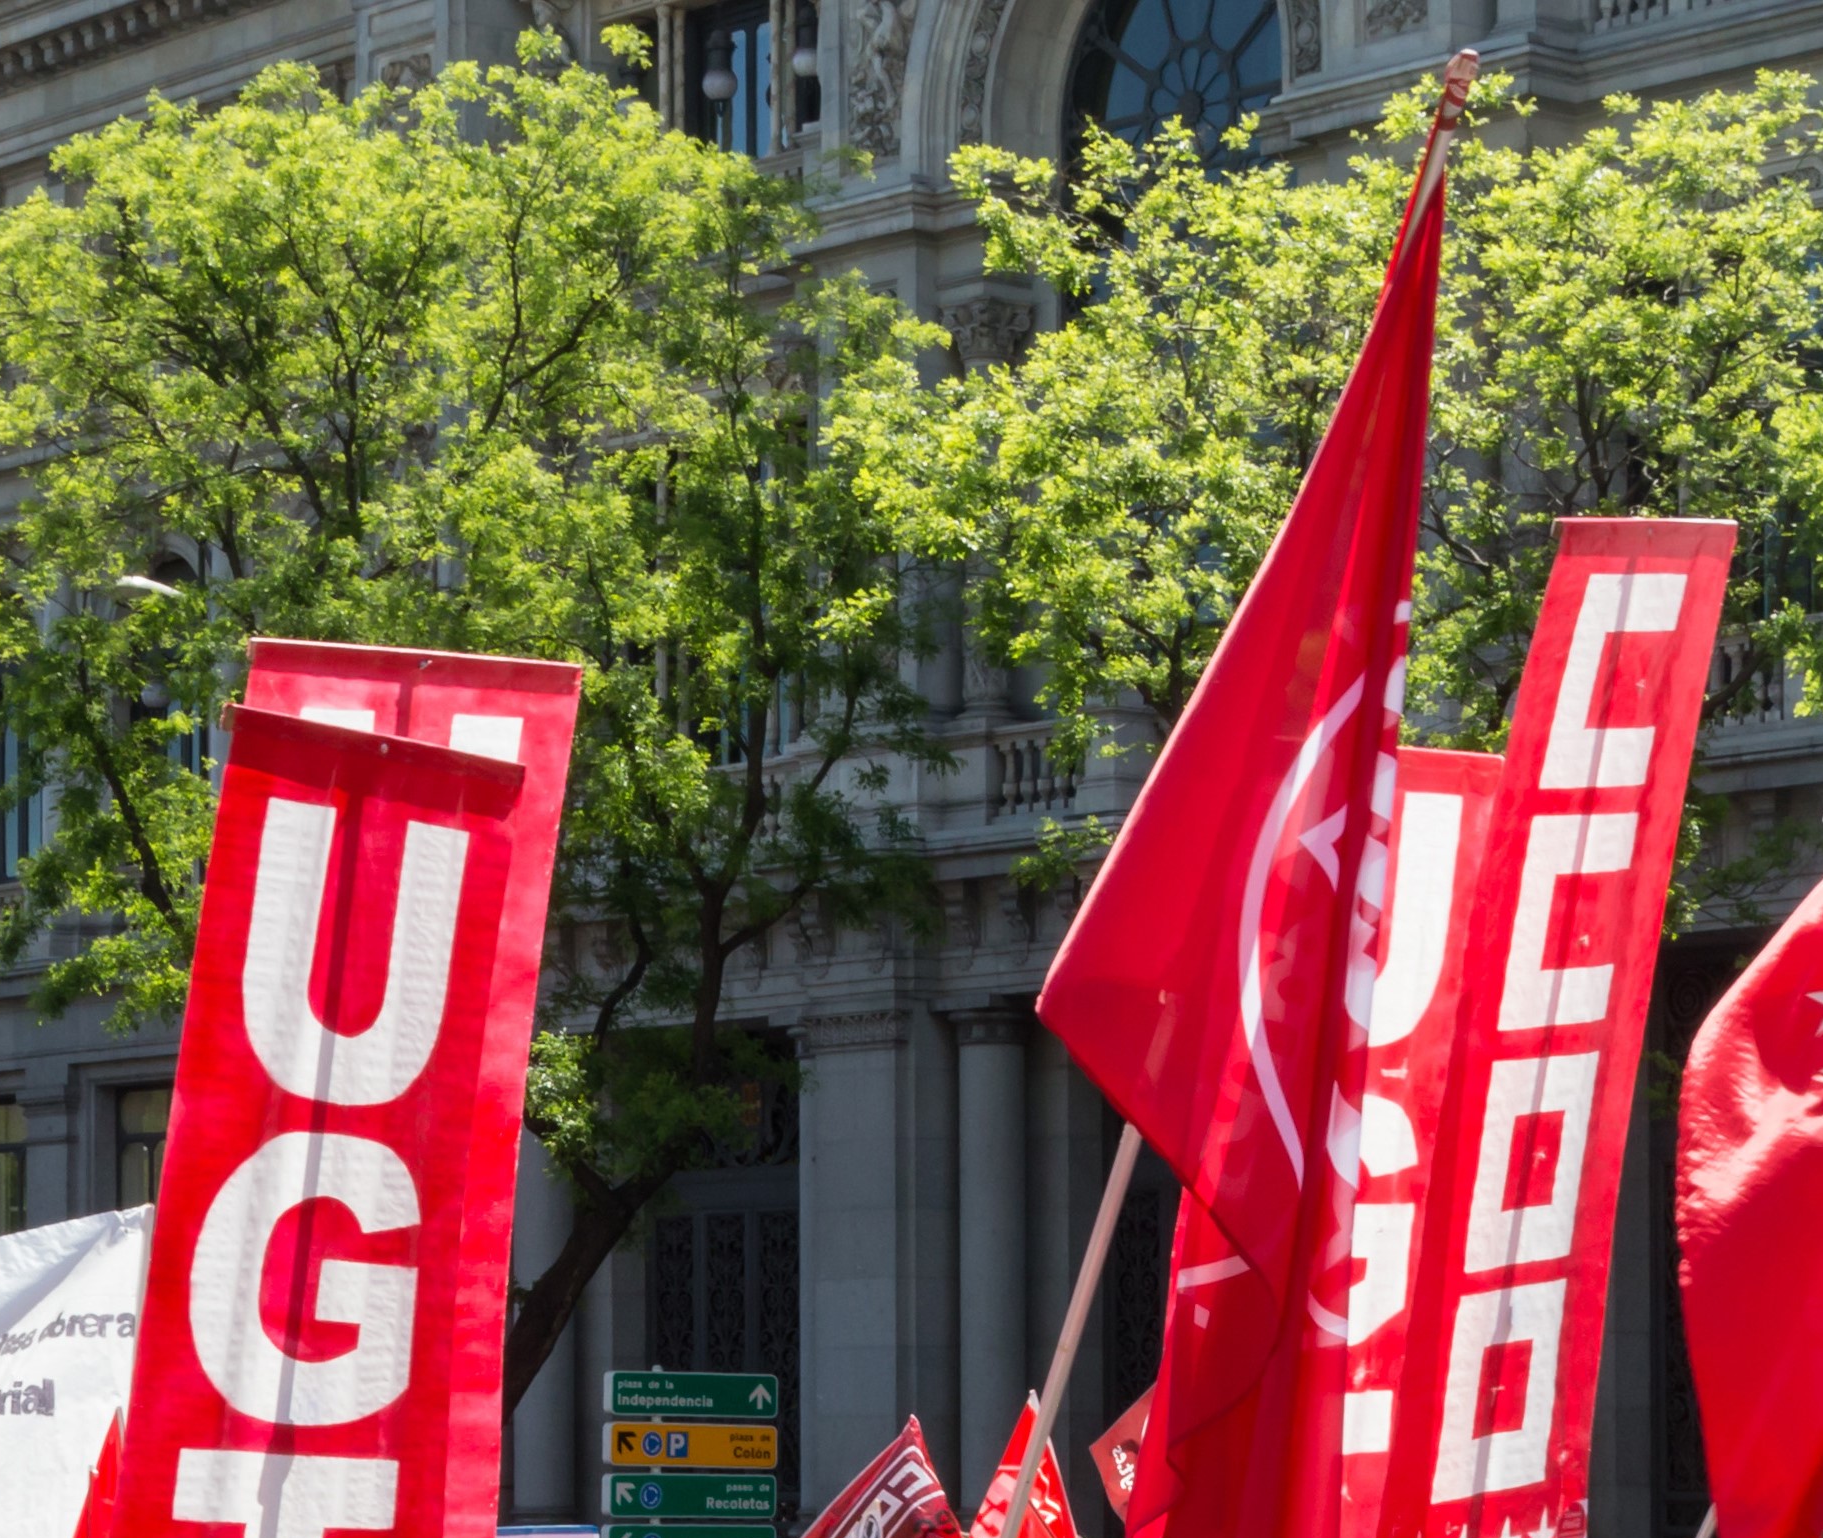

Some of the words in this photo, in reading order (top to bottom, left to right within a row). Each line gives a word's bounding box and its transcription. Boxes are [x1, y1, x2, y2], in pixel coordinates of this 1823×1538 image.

[1431, 573, 1687, 1503] CCOO
[38, 1311, 136, 1344] obrera
[617, 1380, 643, 1390] plaza
[648, 1381, 661, 1389] de
[665, 1380, 674, 1389] la
[617, 1393, 714, 1409] Independencia
[669, 1434, 685, 1456] P
[729, 1433, 754, 1443] plaza
[760, 1433, 771, 1442] de
[733, 1446, 771, 1460] Colón
[726, 1484, 754, 1494] paseo
[759, 1484, 770, 1492] de
[706, 1497, 770, 1511] Recoletos
